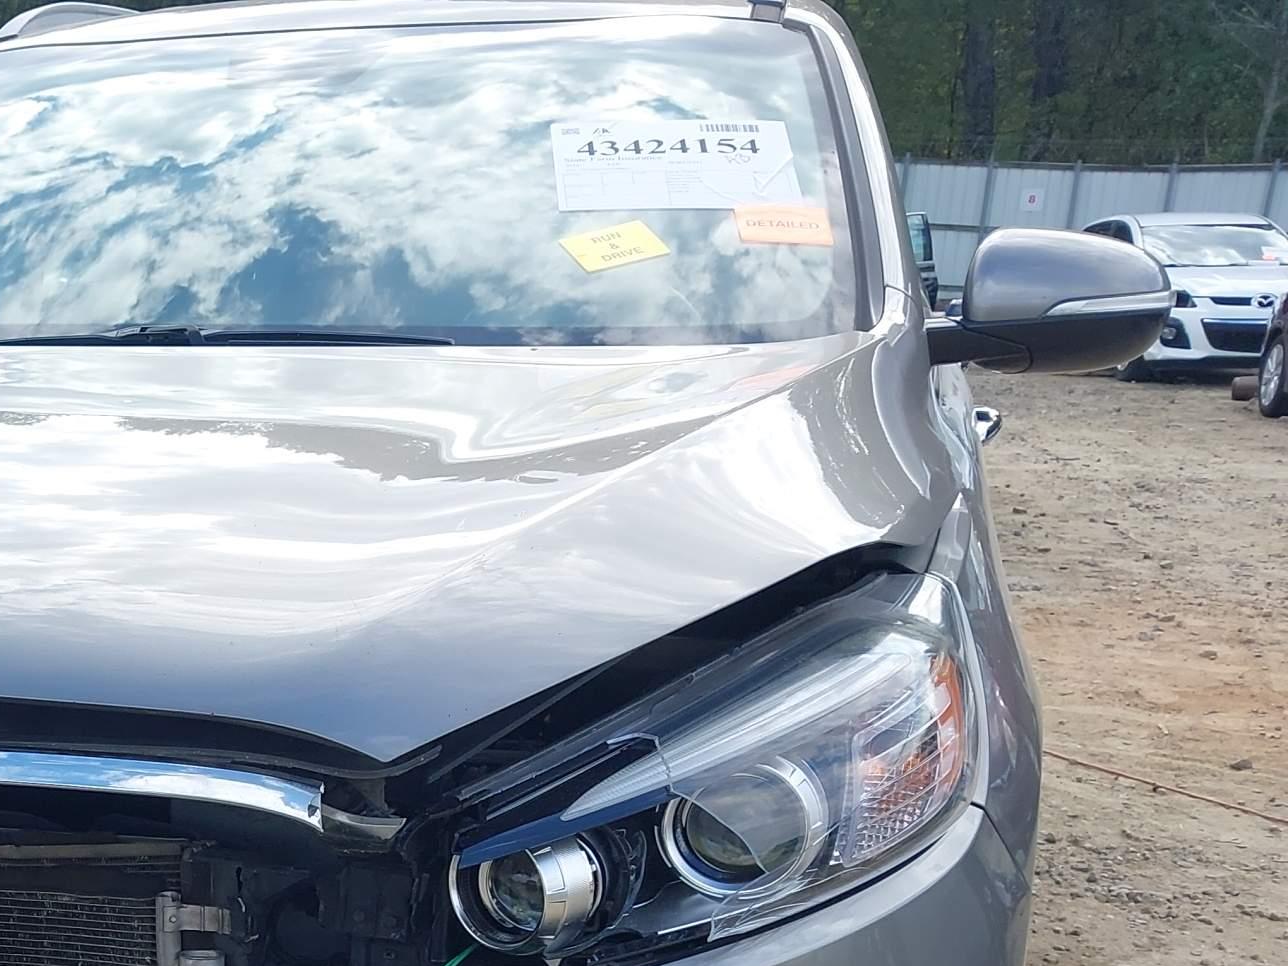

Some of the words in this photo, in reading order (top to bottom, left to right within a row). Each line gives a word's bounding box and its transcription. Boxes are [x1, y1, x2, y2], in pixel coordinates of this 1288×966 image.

[577, 138, 760, 156] 43424154
[746, 219, 820, 230] DETAILED
[591, 231, 622, 244] RUN
[600, 246, 645, 262] DRIVE
